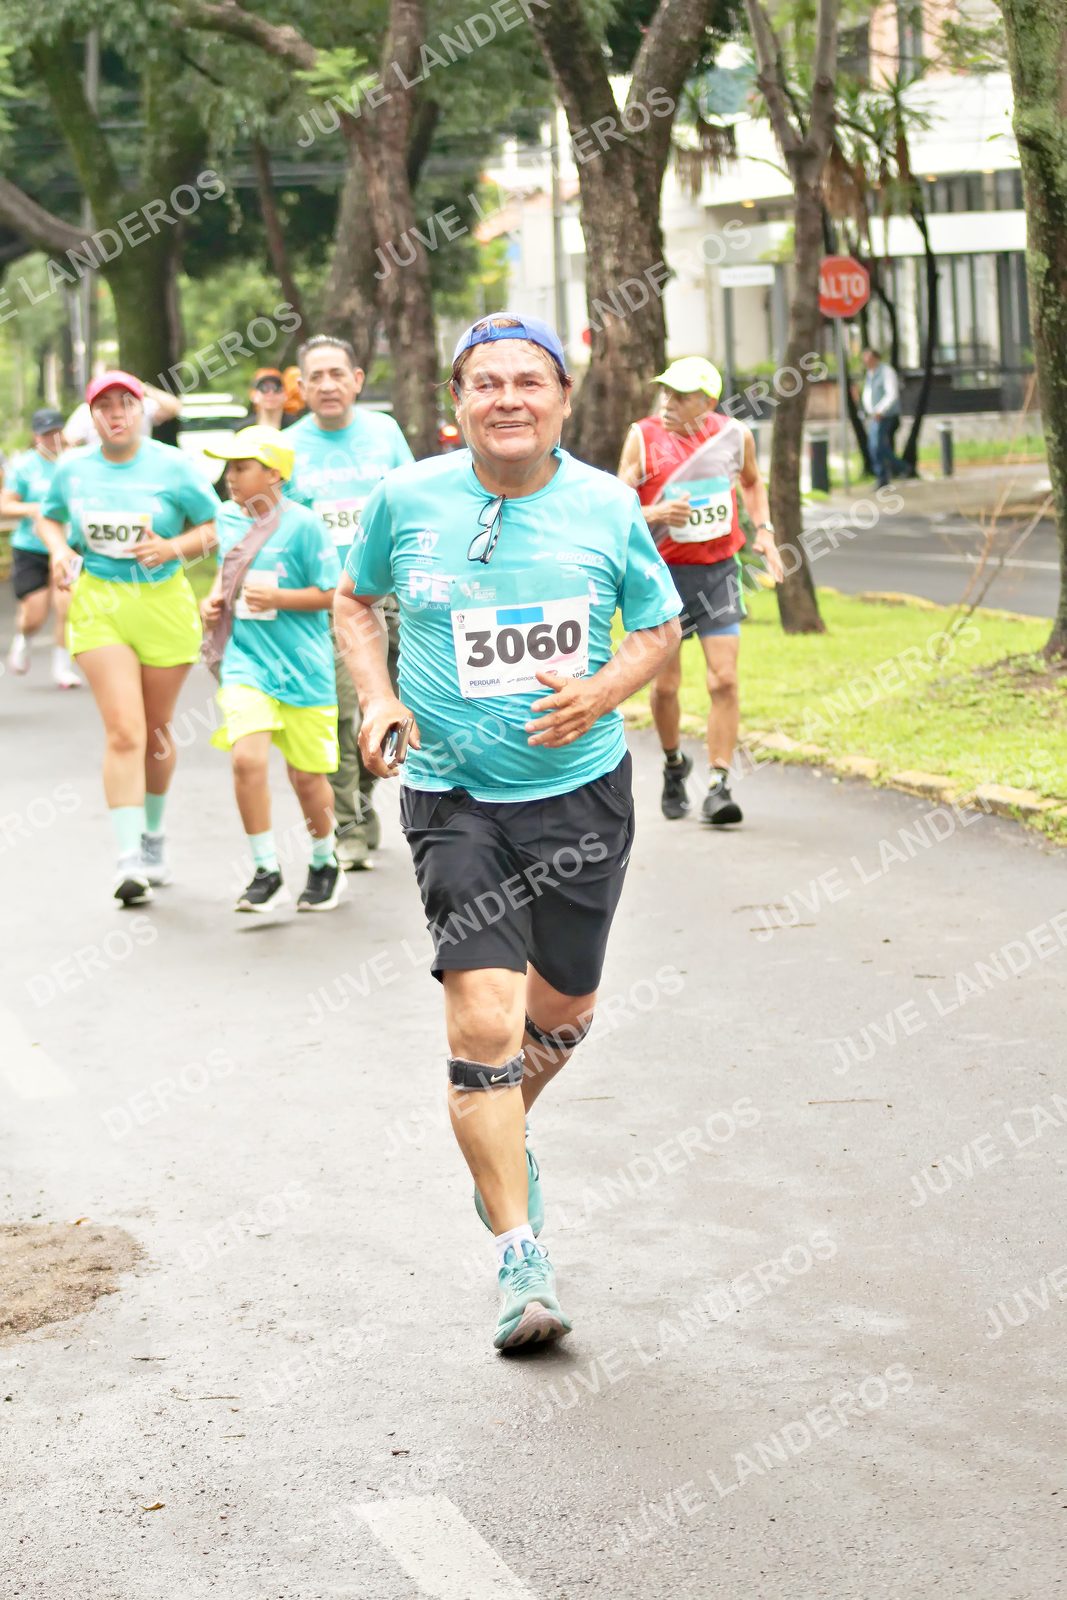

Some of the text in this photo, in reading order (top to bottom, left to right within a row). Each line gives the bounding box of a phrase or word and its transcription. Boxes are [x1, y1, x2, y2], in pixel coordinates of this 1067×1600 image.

[819, 273, 865, 299] ALTO
[88, 523, 146, 543] 2507
[555, 552, 605, 565] BROOKS
[465, 619, 582, 668] 3060
